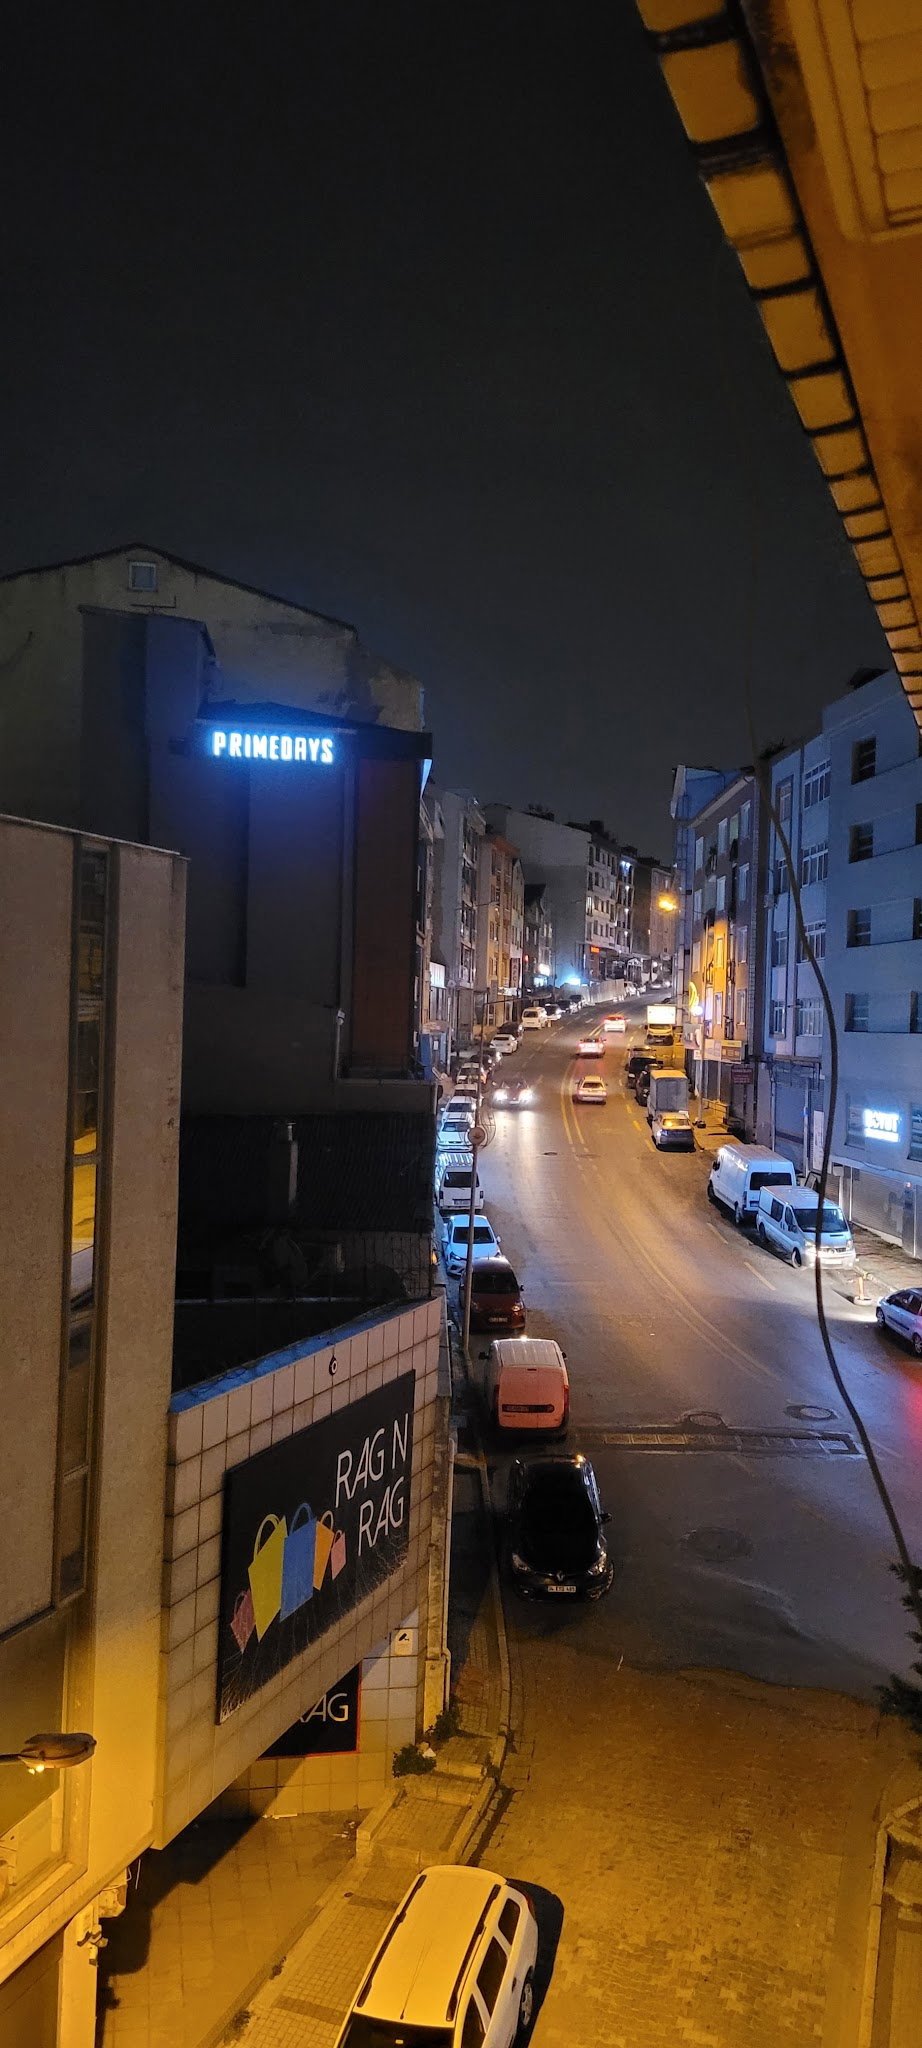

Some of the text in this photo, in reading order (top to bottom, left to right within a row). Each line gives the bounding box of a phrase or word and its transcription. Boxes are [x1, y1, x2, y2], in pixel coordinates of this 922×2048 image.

[212, 731, 334, 764] PRIMEDAYS
[335, 1413, 409, 1508] RAG N
[358, 1476, 405, 1557] RAG
[298, 1692, 349, 1723] AG
